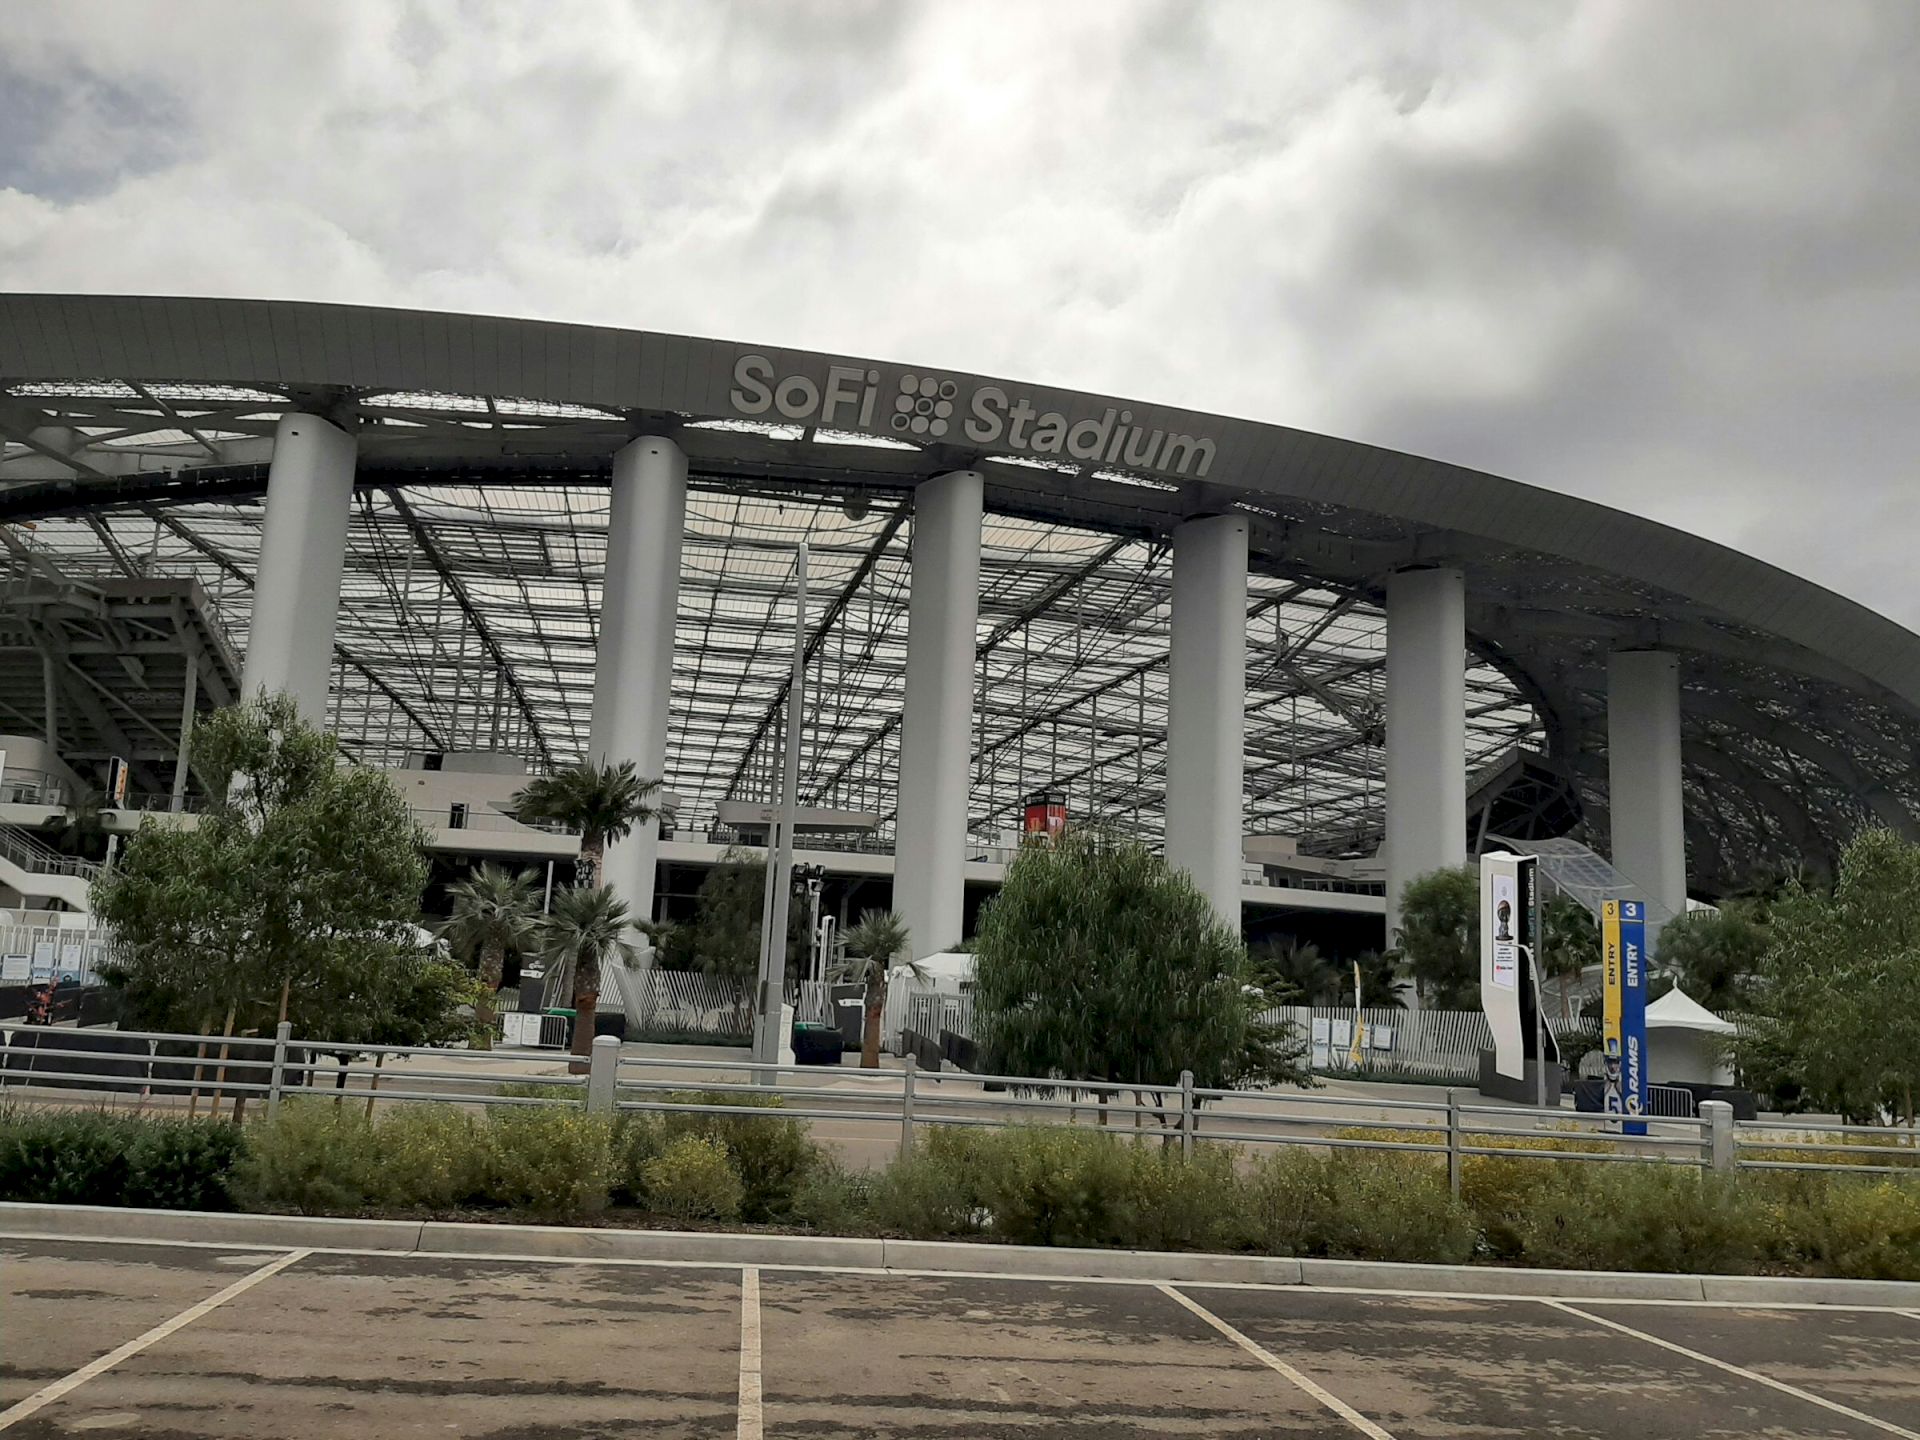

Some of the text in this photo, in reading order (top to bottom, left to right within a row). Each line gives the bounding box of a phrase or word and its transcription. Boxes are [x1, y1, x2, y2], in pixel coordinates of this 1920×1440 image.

[730, 355, 1217, 477] SoFi Stadium
[1607, 903, 1614, 915] 3
[1625, 902, 1637, 917] 3
[1626, 942, 1639, 987] ENTRY
[1628, 1035, 1640, 1093] RAMS
